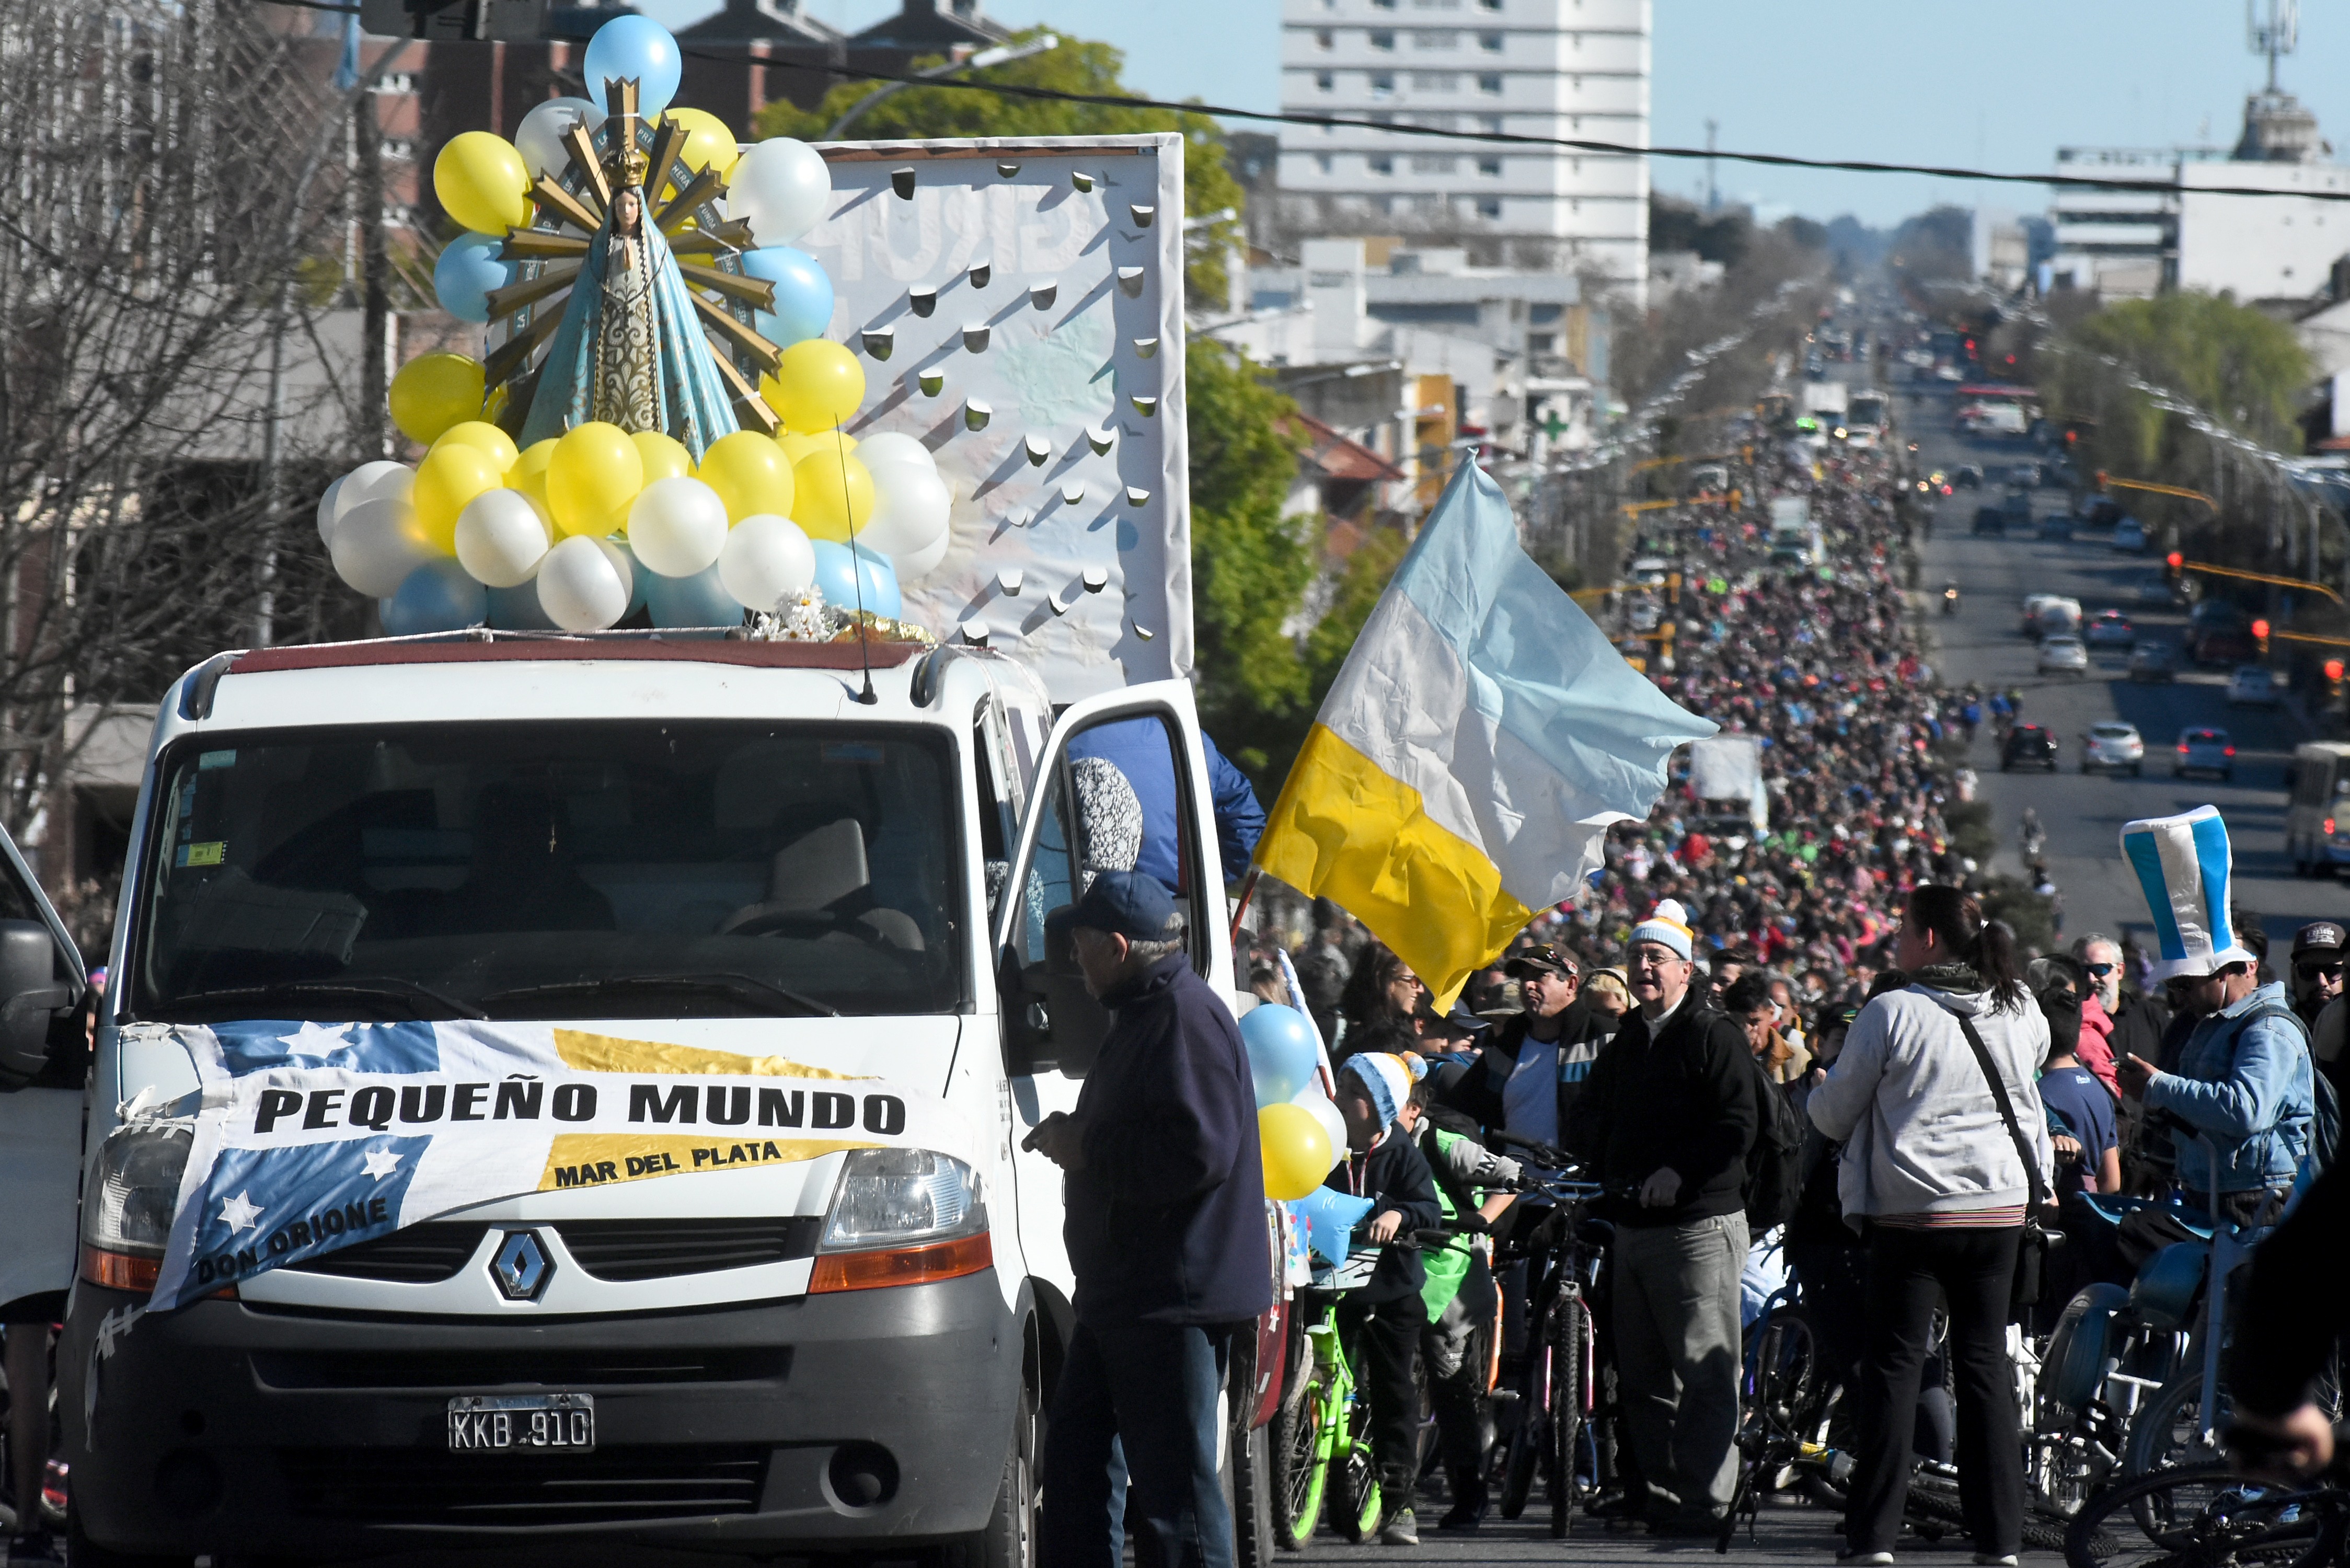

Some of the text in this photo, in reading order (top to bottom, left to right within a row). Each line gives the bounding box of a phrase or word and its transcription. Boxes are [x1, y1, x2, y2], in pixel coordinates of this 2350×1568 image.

[254, 1074, 906, 1136] PEQUEÑO MUNDO
[554, 1140, 782, 1187] MAR DEL PLATA
[197, 1197, 388, 1284] DON ORIONE
[455, 1411, 589, 1448] KKB 910
